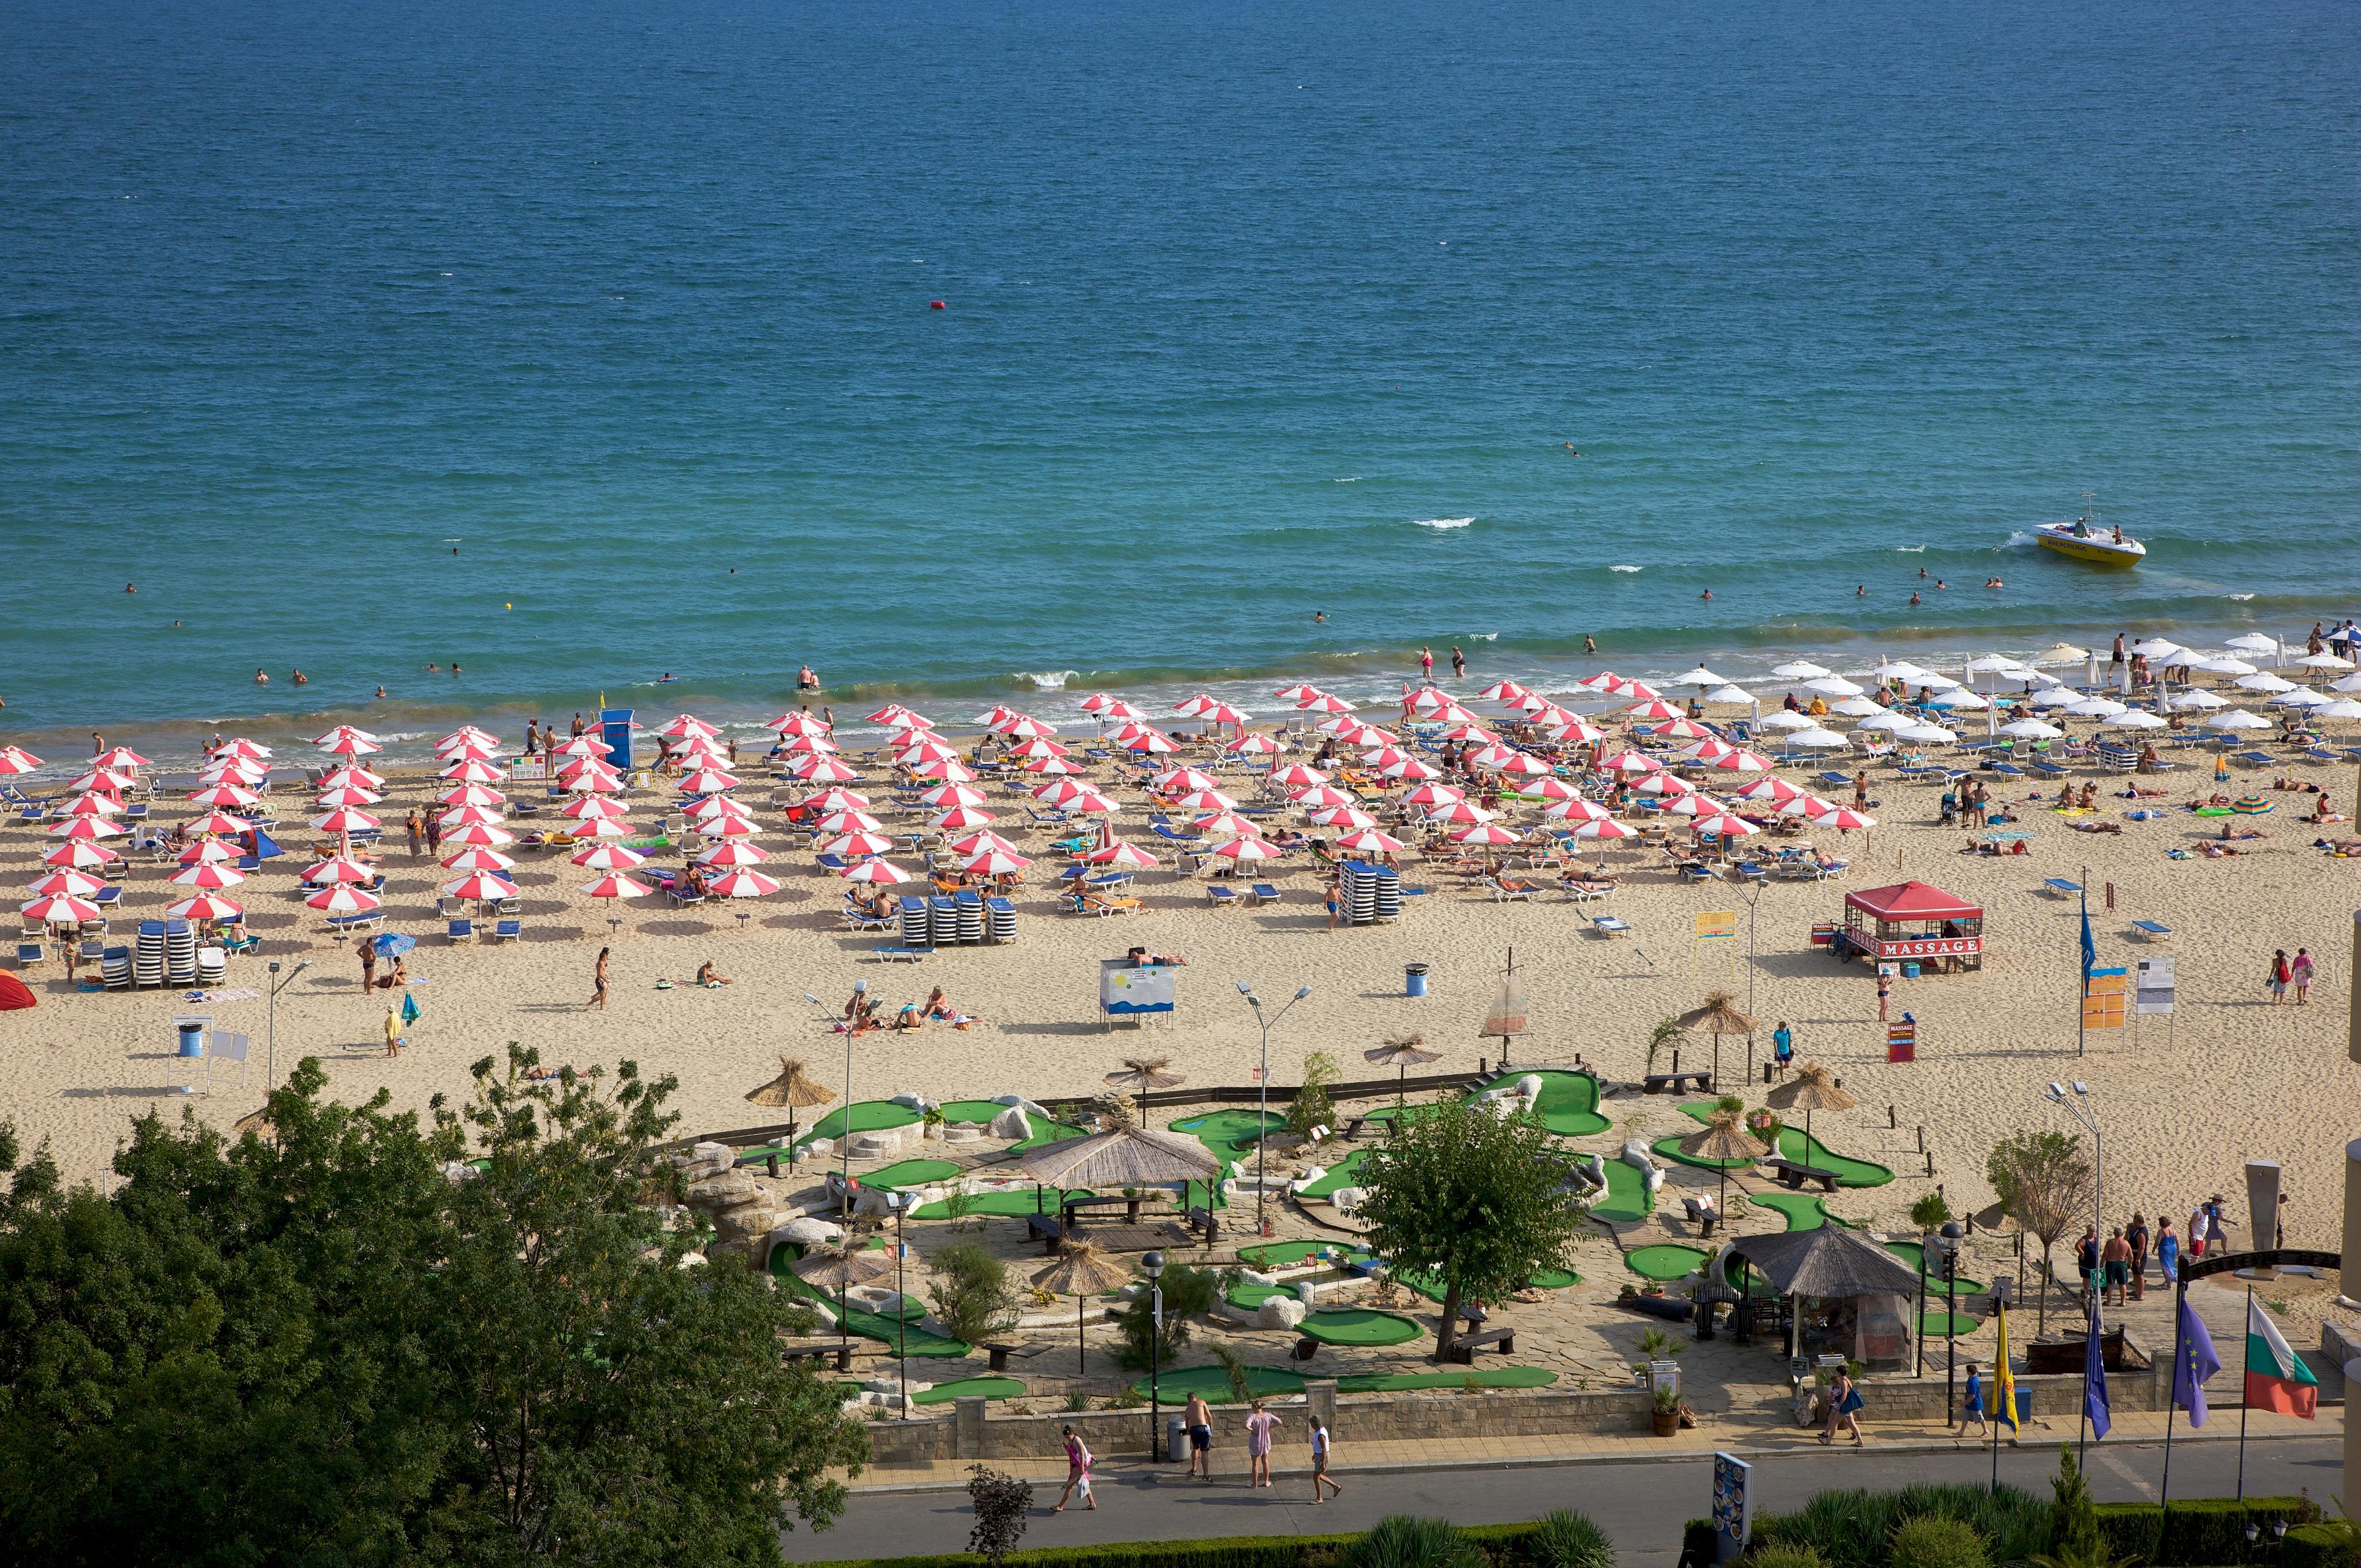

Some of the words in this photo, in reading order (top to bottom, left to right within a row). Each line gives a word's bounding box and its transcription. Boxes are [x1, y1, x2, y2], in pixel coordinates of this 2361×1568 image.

[1845, 925, 1880, 953] MASSAGE
[1884, 940, 1977, 955] MASSAGE
[851, 1180, 857, 1189] 6
[887, 1247, 892, 1256] 5
[1306, 1256, 1314, 1265] 18
